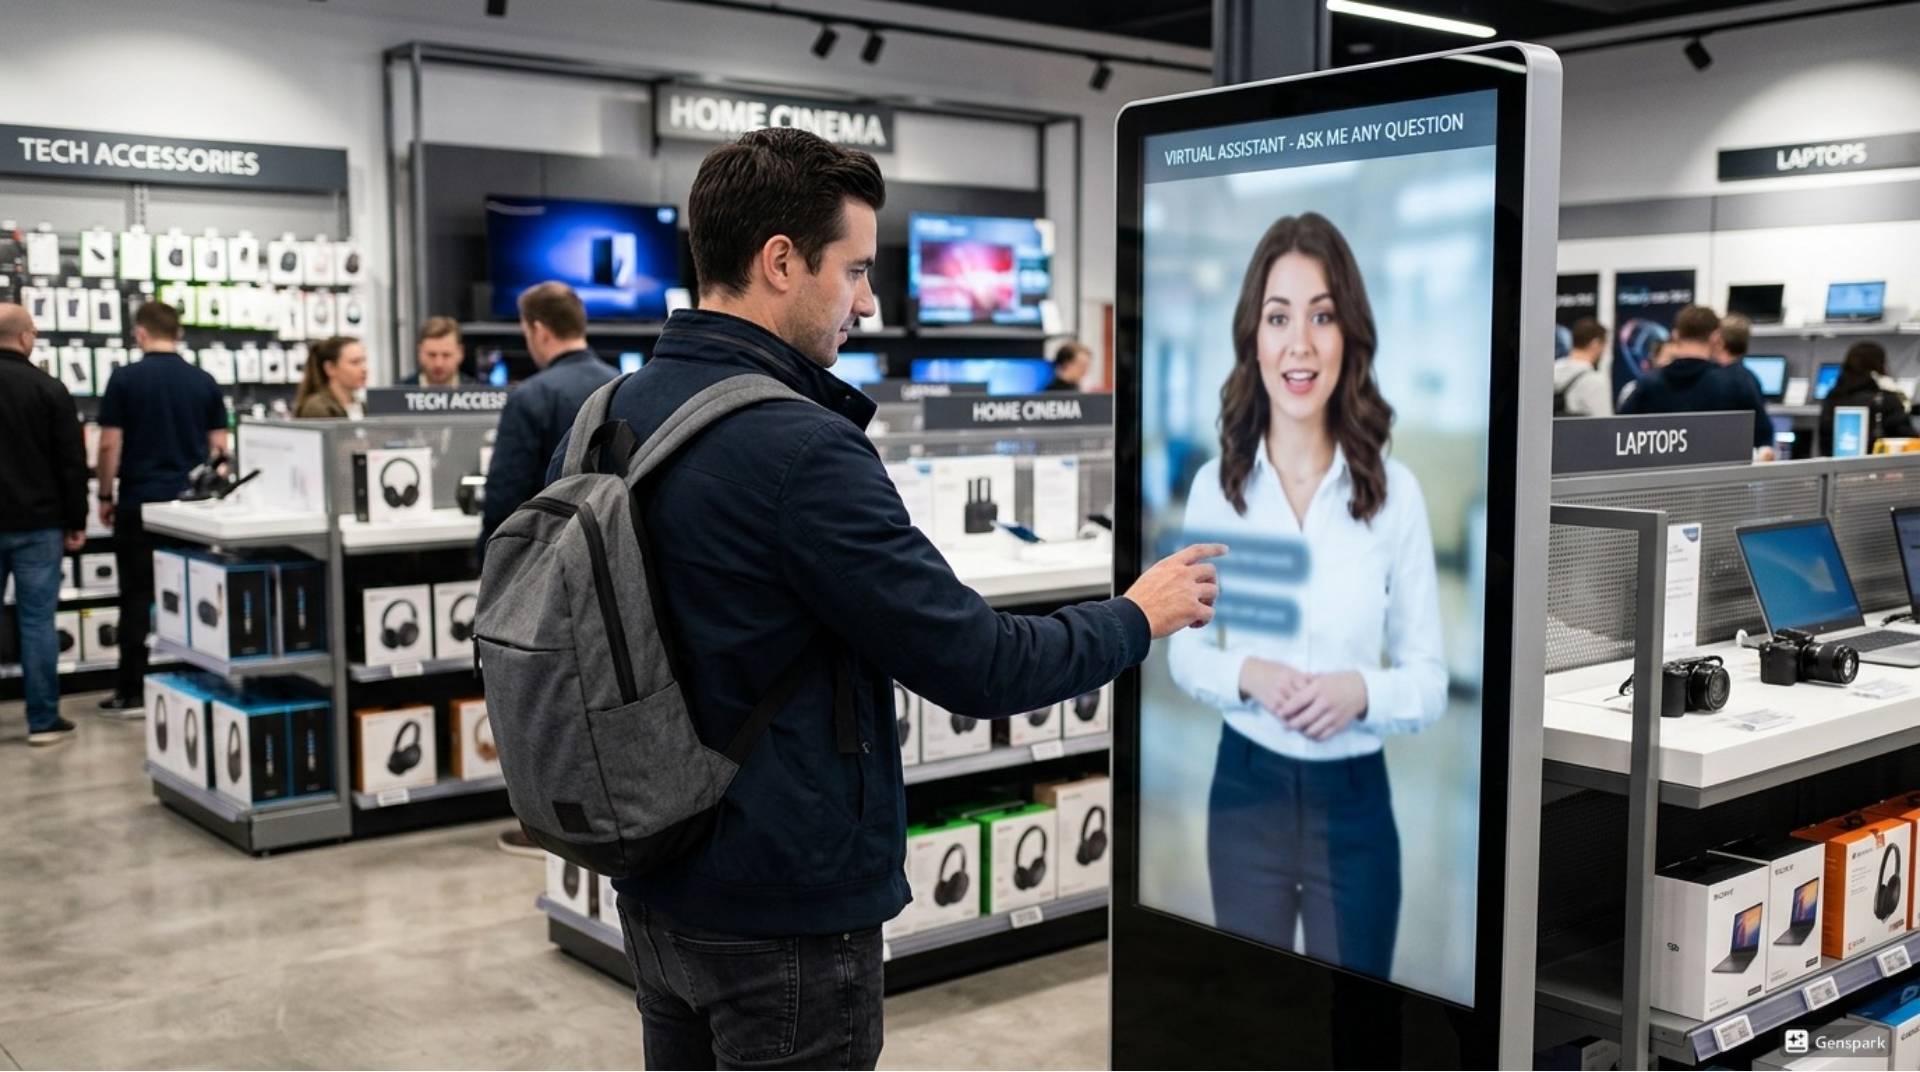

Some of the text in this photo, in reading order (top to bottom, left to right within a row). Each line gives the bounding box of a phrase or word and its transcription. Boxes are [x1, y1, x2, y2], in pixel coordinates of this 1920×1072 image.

[670, 95, 886, 146] HOME CINEMA
[1165, 146, 1215, 166] VIRTUAL
[1218, 136, 1287, 160] ASSISTANT
[1297, 131, 1323, 150] ASK
[1326, 128, 1348, 146] ME
[1351, 123, 1382, 143] ANY
[1385, 112, 1464, 140] QUESTION
[17, 136, 260, 176] TECH ACCESSORIES
[1776, 142, 1867, 171] LAPTOPS
[404, 391, 448, 411] TECH
[973, 399, 1082, 422] HOME CINEMA
[1616, 428, 1688, 456] LAPTOPS
